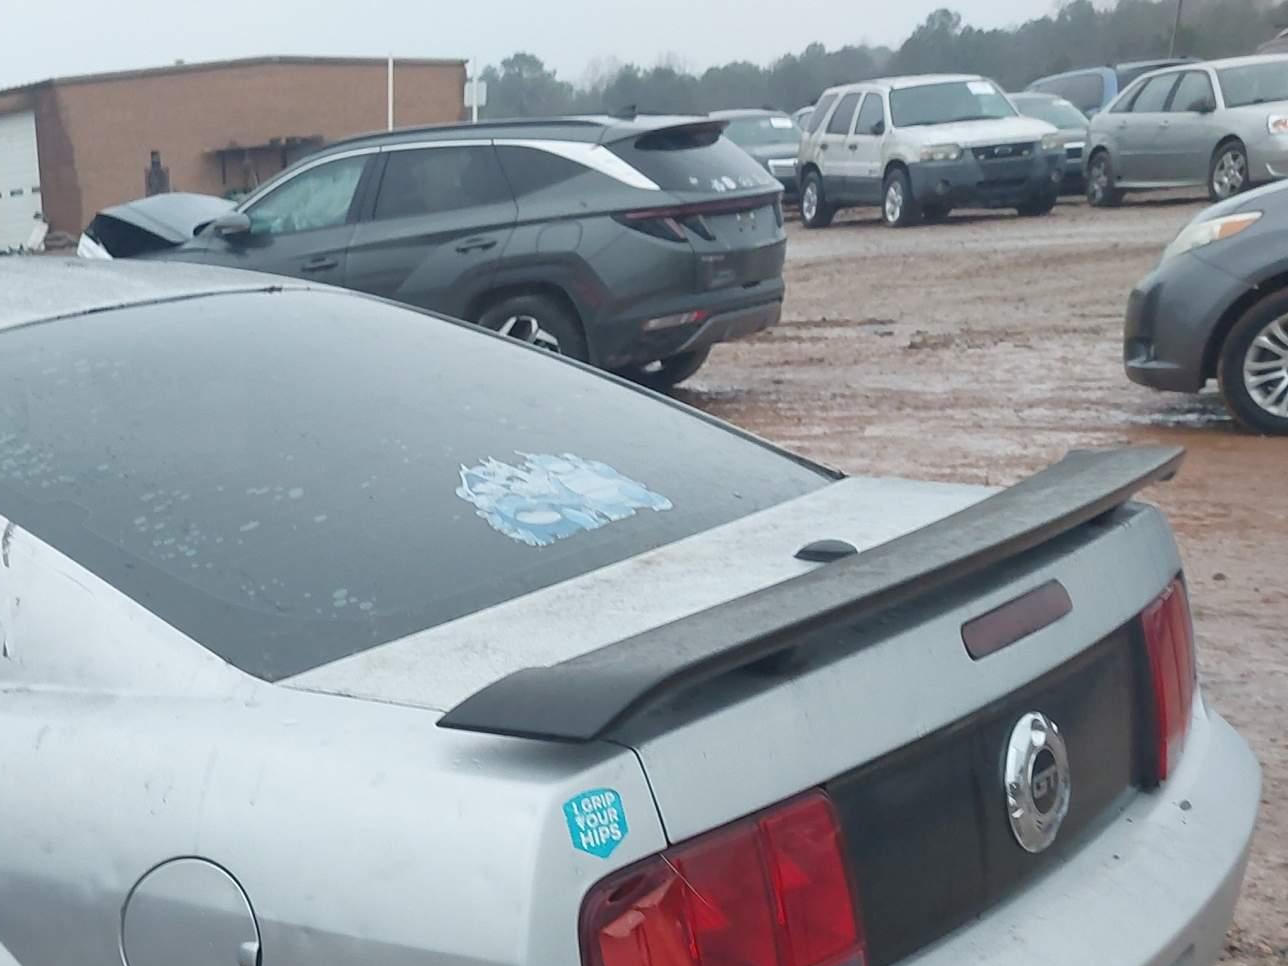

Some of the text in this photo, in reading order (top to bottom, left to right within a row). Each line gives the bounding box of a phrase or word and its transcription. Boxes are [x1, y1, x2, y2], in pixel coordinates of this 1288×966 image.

[572, 791, 616, 816] I GRIP
[575, 807, 619, 831] YOUR
[579, 823, 622, 850] HIPS
